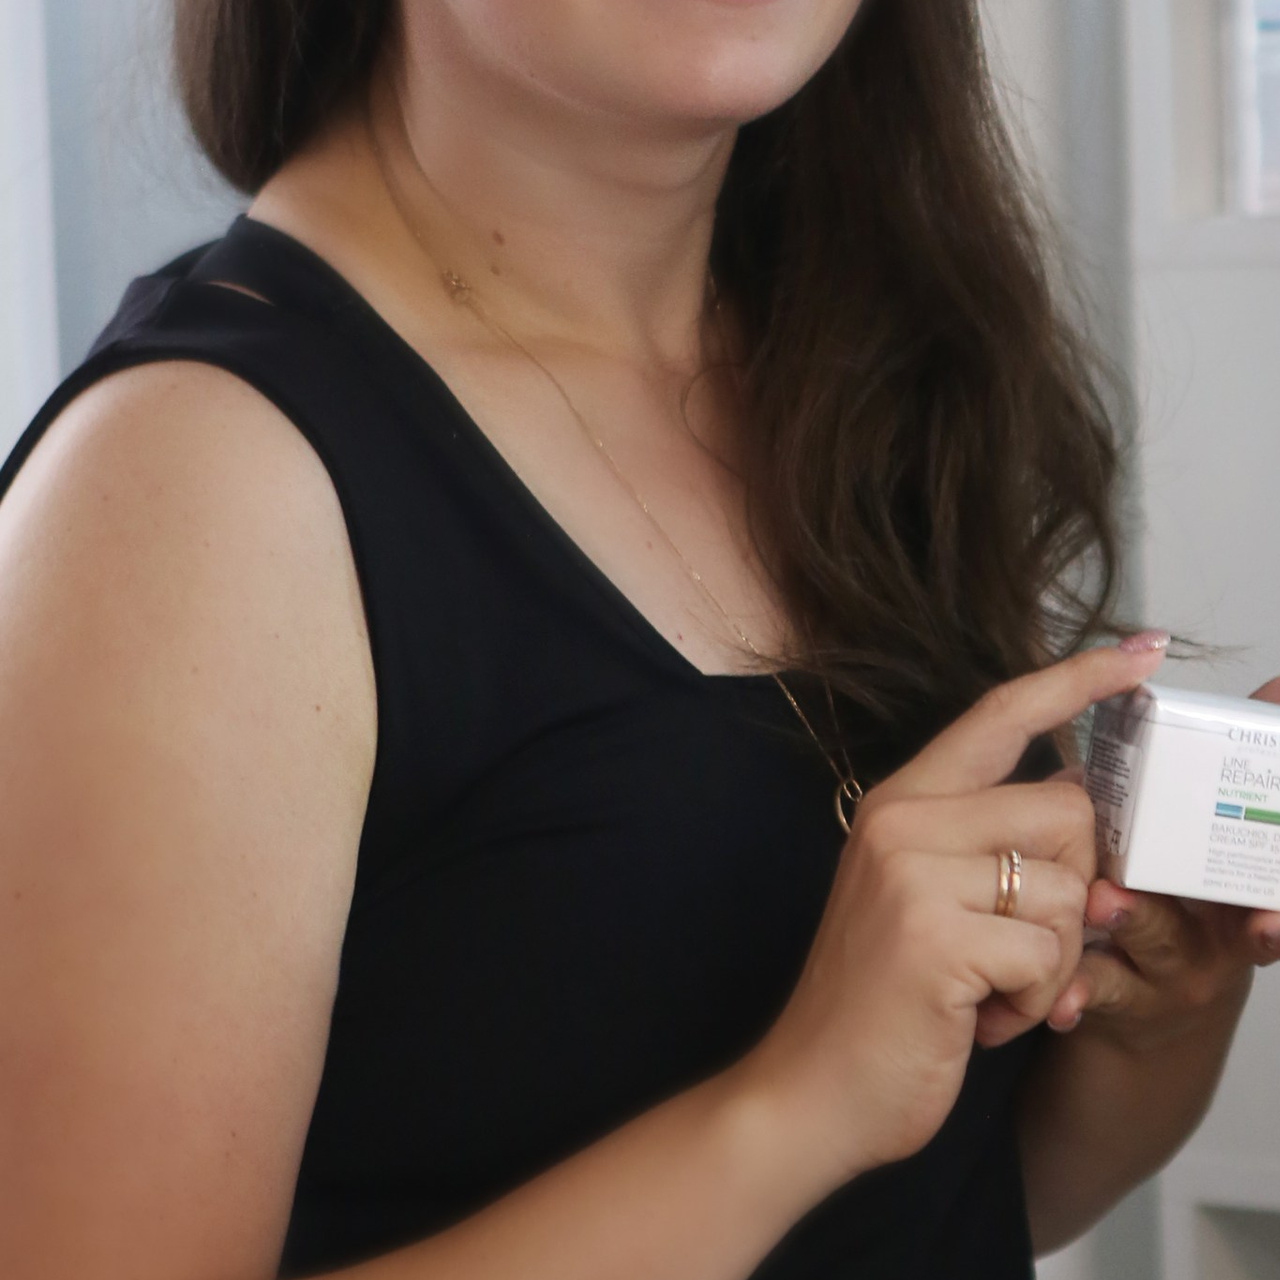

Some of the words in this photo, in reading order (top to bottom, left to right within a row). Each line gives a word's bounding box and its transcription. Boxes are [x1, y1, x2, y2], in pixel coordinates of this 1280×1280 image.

[1223, 756, 1250, 770] LINE
[1217, 786, 1268, 803] NUTRIENT
[1209, 834, 1246, 847] CREAM
